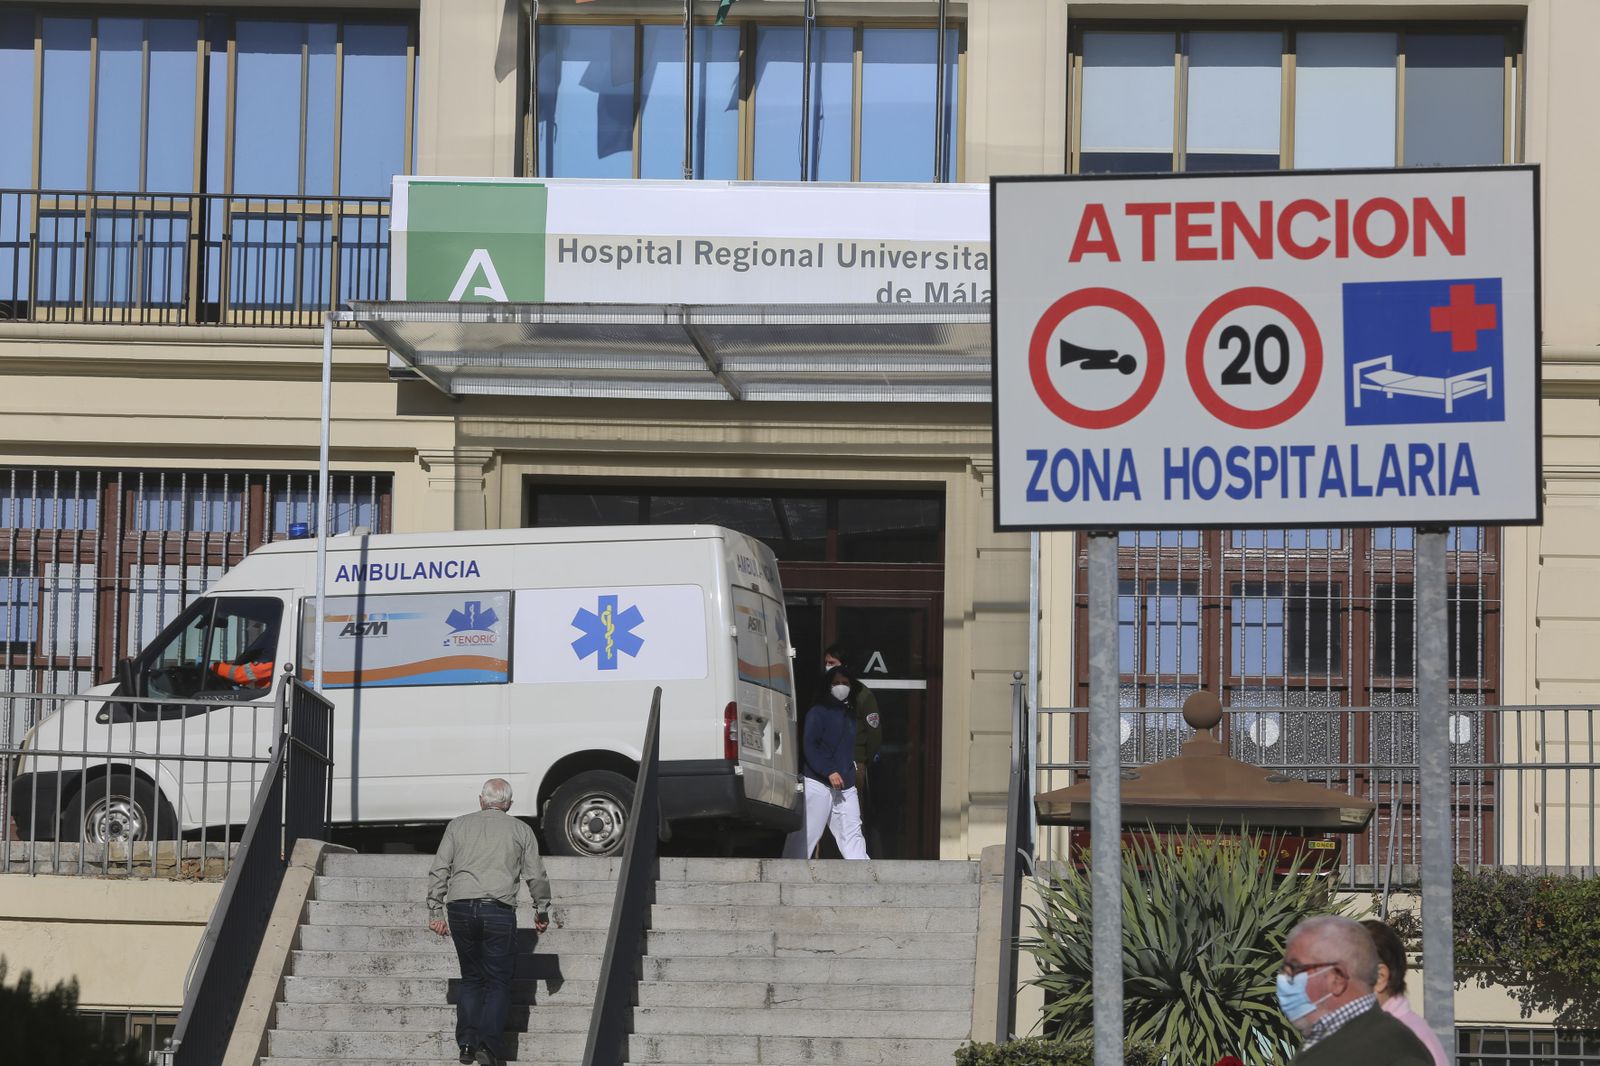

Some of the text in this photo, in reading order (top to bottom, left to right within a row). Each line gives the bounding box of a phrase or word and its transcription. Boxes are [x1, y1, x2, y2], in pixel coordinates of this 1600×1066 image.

[1068, 196, 1466, 263] ATENCION
[558, 238, 683, 269] Hospital
[695, 241, 824, 272] Regional
[876, 281, 912, 303] de
[1219, 323, 1291, 386] 20
[1026, 442, 1480, 503] ZONA HOSPITALARIA
[335, 560, 481, 583] AMBULANCIA
[339, 621, 388, 636] ASM
